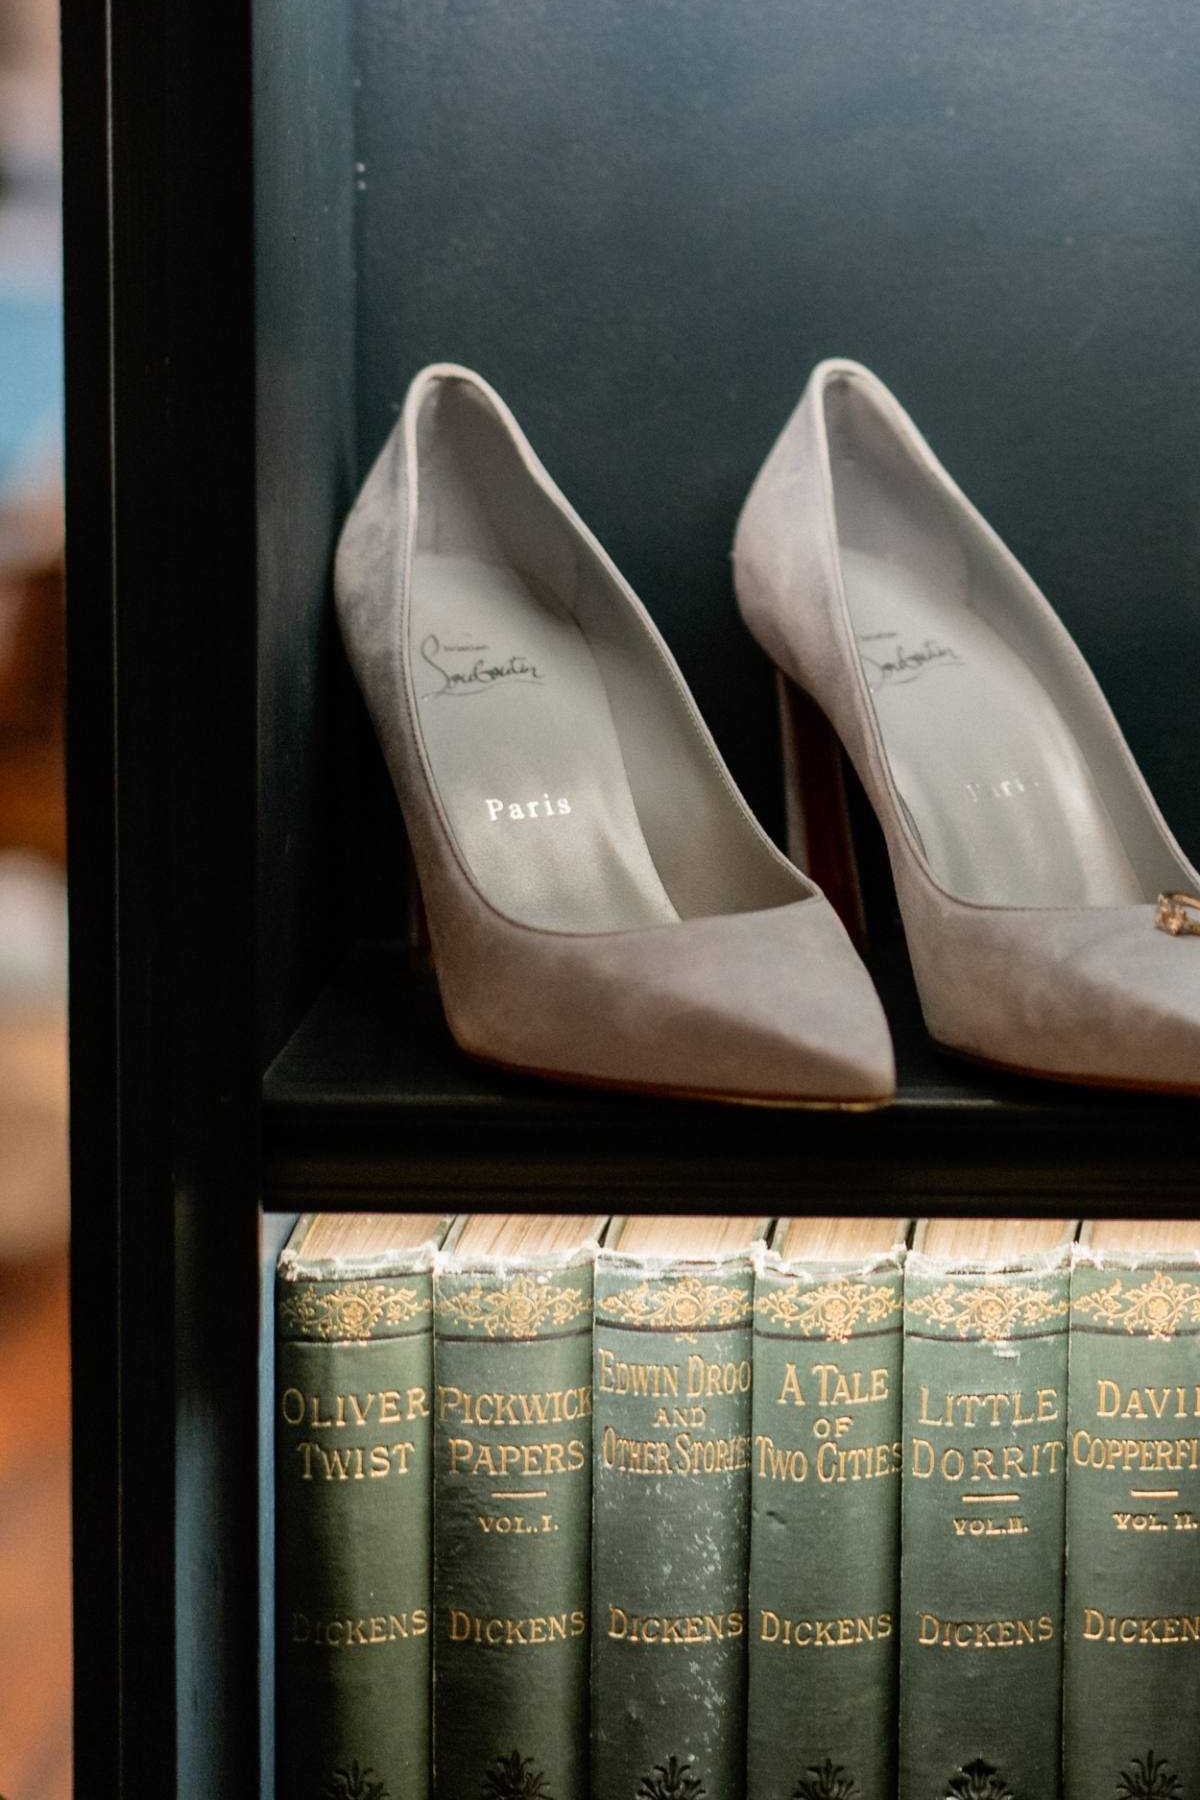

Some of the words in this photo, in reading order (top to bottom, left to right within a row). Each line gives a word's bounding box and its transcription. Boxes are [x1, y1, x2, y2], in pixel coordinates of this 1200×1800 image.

[485, 792, 572, 822] Paris
[598, 1347, 680, 1397] EDWIN
[685, 1354, 751, 1398] DROO
[777, 1363, 806, 1406] A
[812, 1364, 889, 1406] TALE
[281, 1387, 430, 1430] OLIVER
[438, 1385, 593, 1425] PICKWICK
[652, 1406, 707, 1428] AND
[918, 1386, 1058, 1427] LITTLE
[813, 1416, 853, 1439] OF
[296, 1441, 415, 1481] TWIST
[449, 1438, 585, 1476] PAPERS
[602, 1426, 673, 1475] OTHER
[674, 1431, 751, 1474] STORIE
[755, 1435, 808, 1482] TWO
[816, 1441, 902, 1483] CITIES
[912, 1438, 1064, 1481] DORRIT
[292, 1608, 428, 1645] DICKENS
[449, 1609, 585, 1644] DICKENS
[608, 1605, 744, 1644] DICKENS
[760, 1609, 892, 1645] DICKENS
[918, 1612, 1054, 1647] DICKENS
